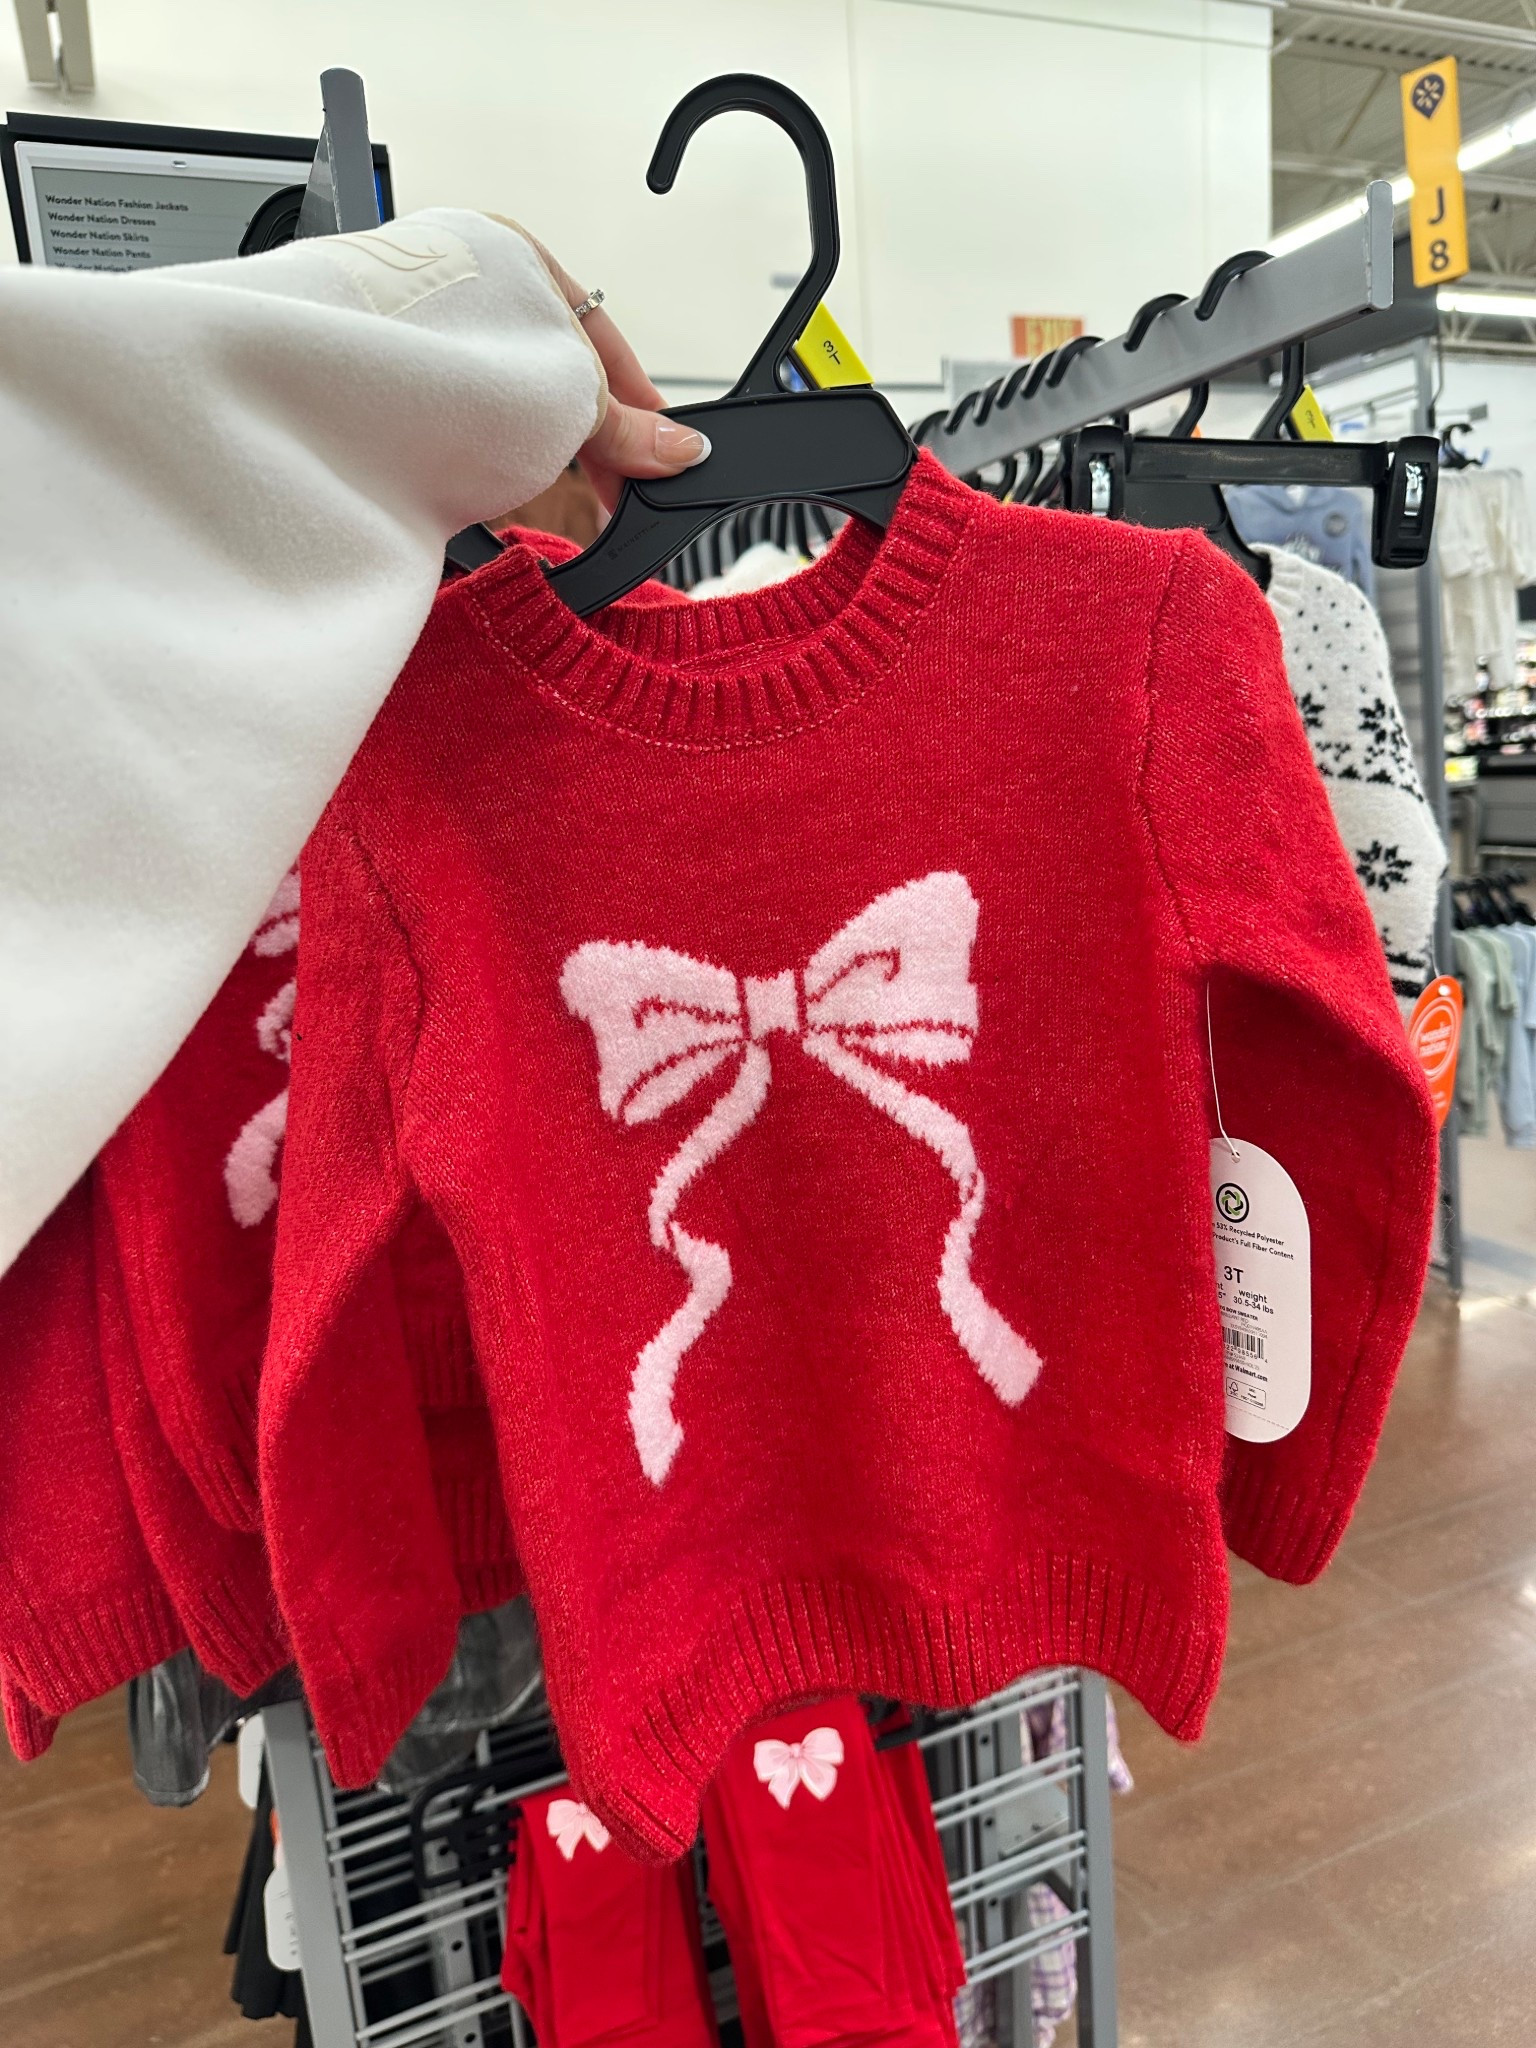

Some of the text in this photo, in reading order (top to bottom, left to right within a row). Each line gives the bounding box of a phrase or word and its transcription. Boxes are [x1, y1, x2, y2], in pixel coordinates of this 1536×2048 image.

[45, 194, 189, 212] Wonder Nation Fashion Jackets
[1428, 186, 1444, 225] J
[48, 212, 156, 226] Wonder Nation Dresses
[50, 229, 149, 242] Wonder Nation Skirts
[52, 246, 151, 259] Wonder Nation Pants
[1430, 240, 1449, 272] 8
[823, 340, 841, 365] 3T
[1216, 1221, 1228, 1231] 53%
[1229, 1225, 1255, 1239] Recycled
[1256, 1232, 1285, 1246] Polyester
[1240, 1239, 1251, 1248] Full
[1252, 1242, 1268, 1253] Fiber
[1268, 1247, 1294, 1260] Content
[1223, 1265, 1244, 1284] 3T
[1232, 1295, 1274, 1315] 30.5-34 lbs
[1238, 1289, 1268, 1304] weight
[1234, 1364, 1268, 1382] Walmart.com
